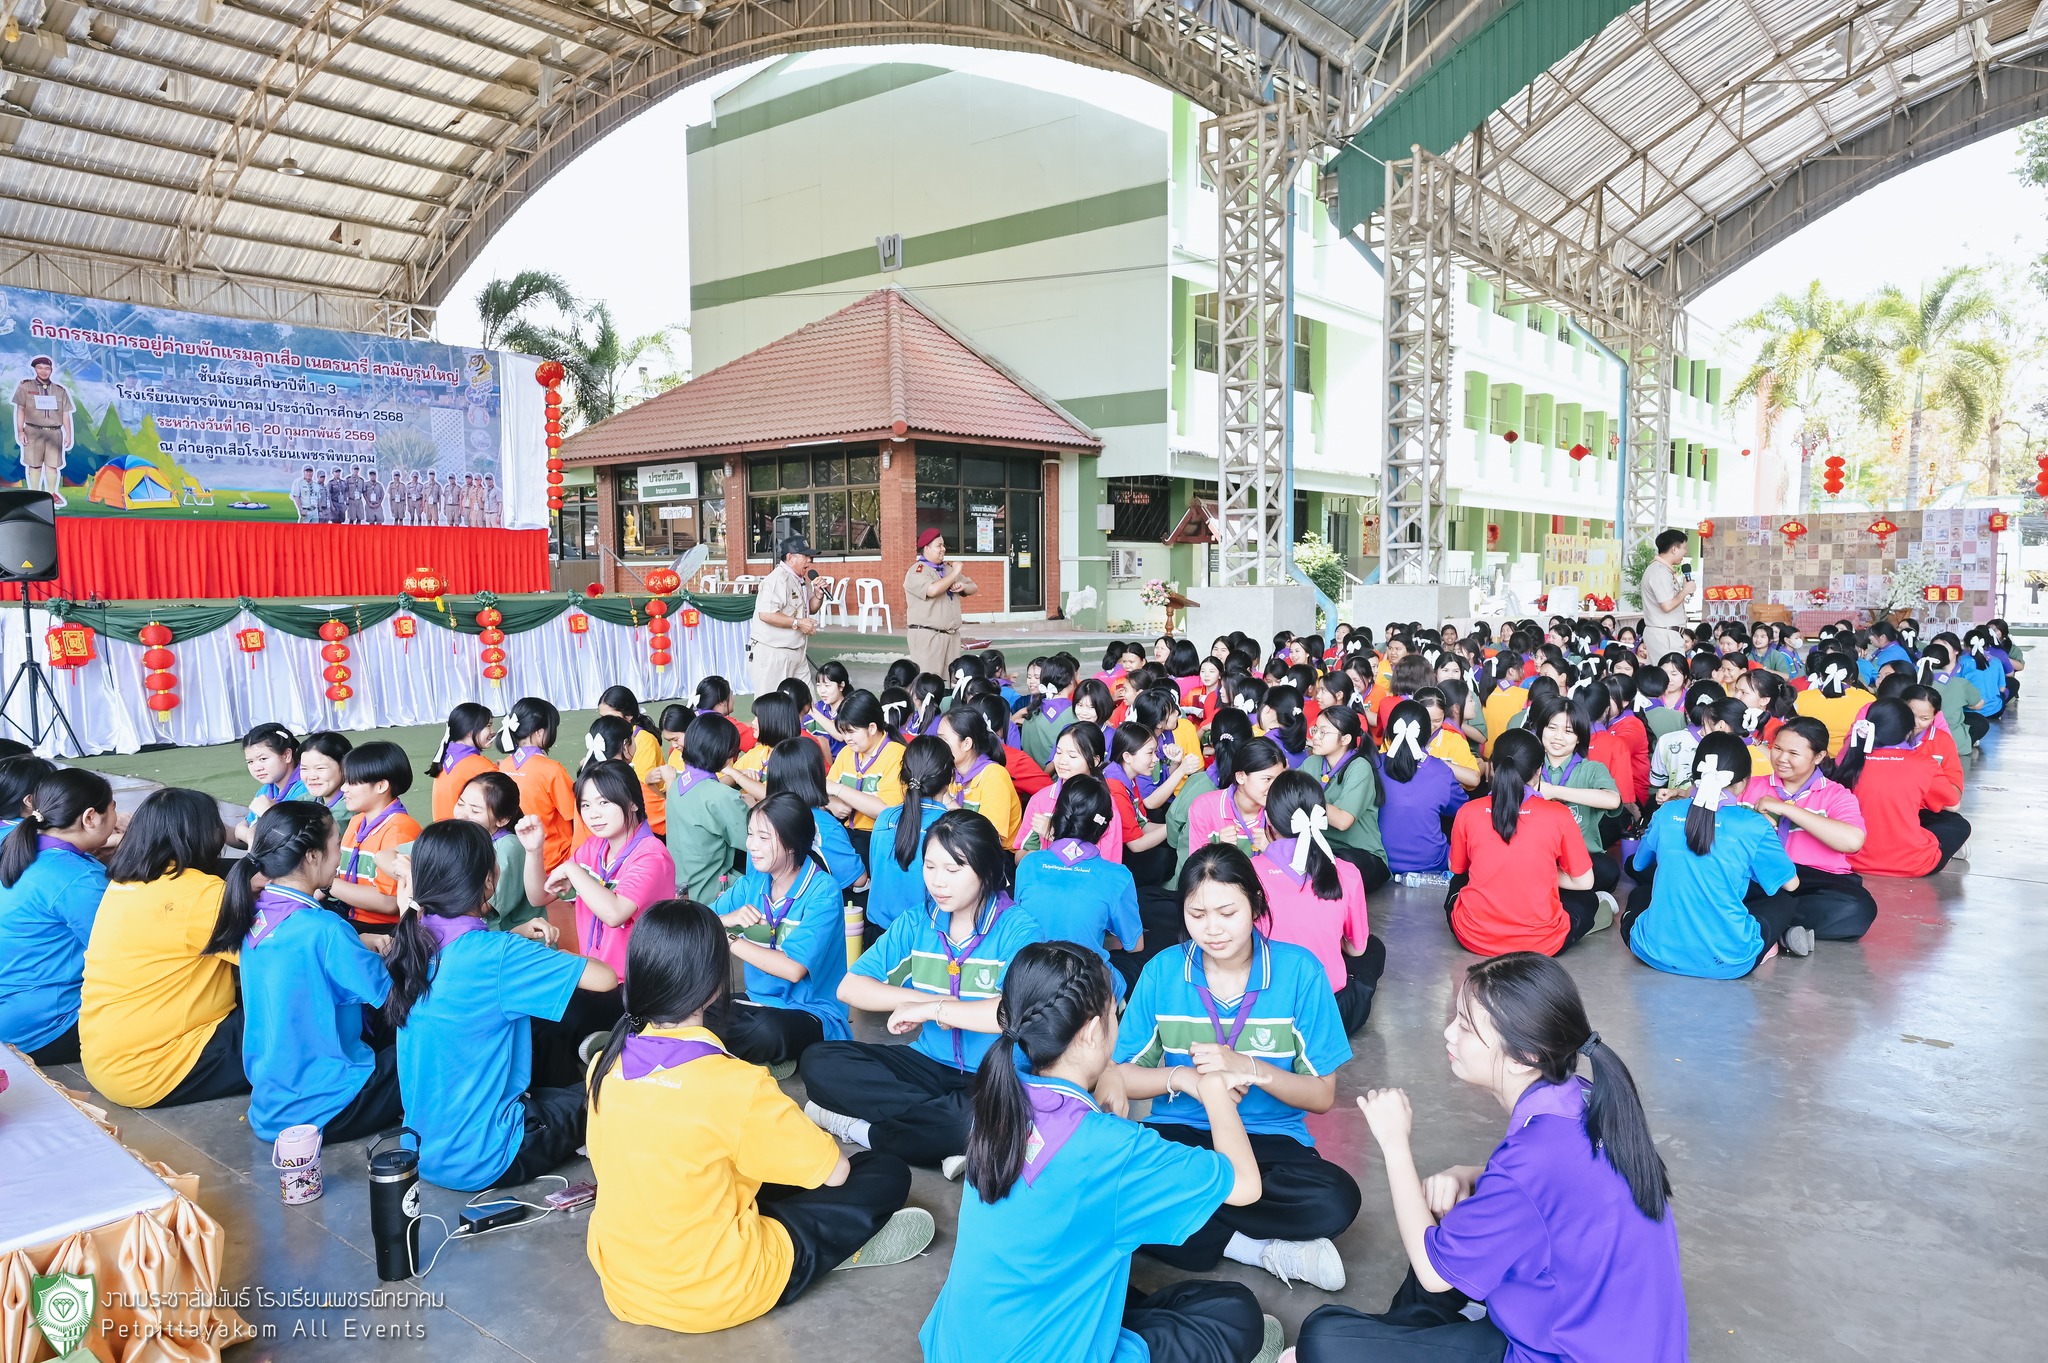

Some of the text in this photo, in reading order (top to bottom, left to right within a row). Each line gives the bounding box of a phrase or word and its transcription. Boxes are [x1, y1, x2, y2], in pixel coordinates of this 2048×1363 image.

[31, 318, 301, 367] กิจกรรมการอยู่ค่ายพักแรมลูกเสือ
[306, 355, 368, 373] เนตรนารี
[373, 361, 459, 387] สามัญรุ่นใหญ่
[197, 364, 307, 392] ชั้นมัธยมศึกษาปีที่
[310, 383, 316, 393] 1
[328, 384, 337, 395] 3
[116, 384, 404, 422] โรงเรียนเพชรพิทยาคม ประจำปีการศึกษา 2568
[157, 415, 233, 432] ระหว่างวันที่
[236, 422, 251, 433] 16
[264, 424, 281, 435] 20
[284, 426, 341, 441] กุมภาพันธ์
[344, 430, 375, 441] 2569
[159, 440, 375, 464] ณ ค่ายลูกเสือโรงเรียนเพชรพิทยาคม
[655, 487, 677, 495] Insurance
